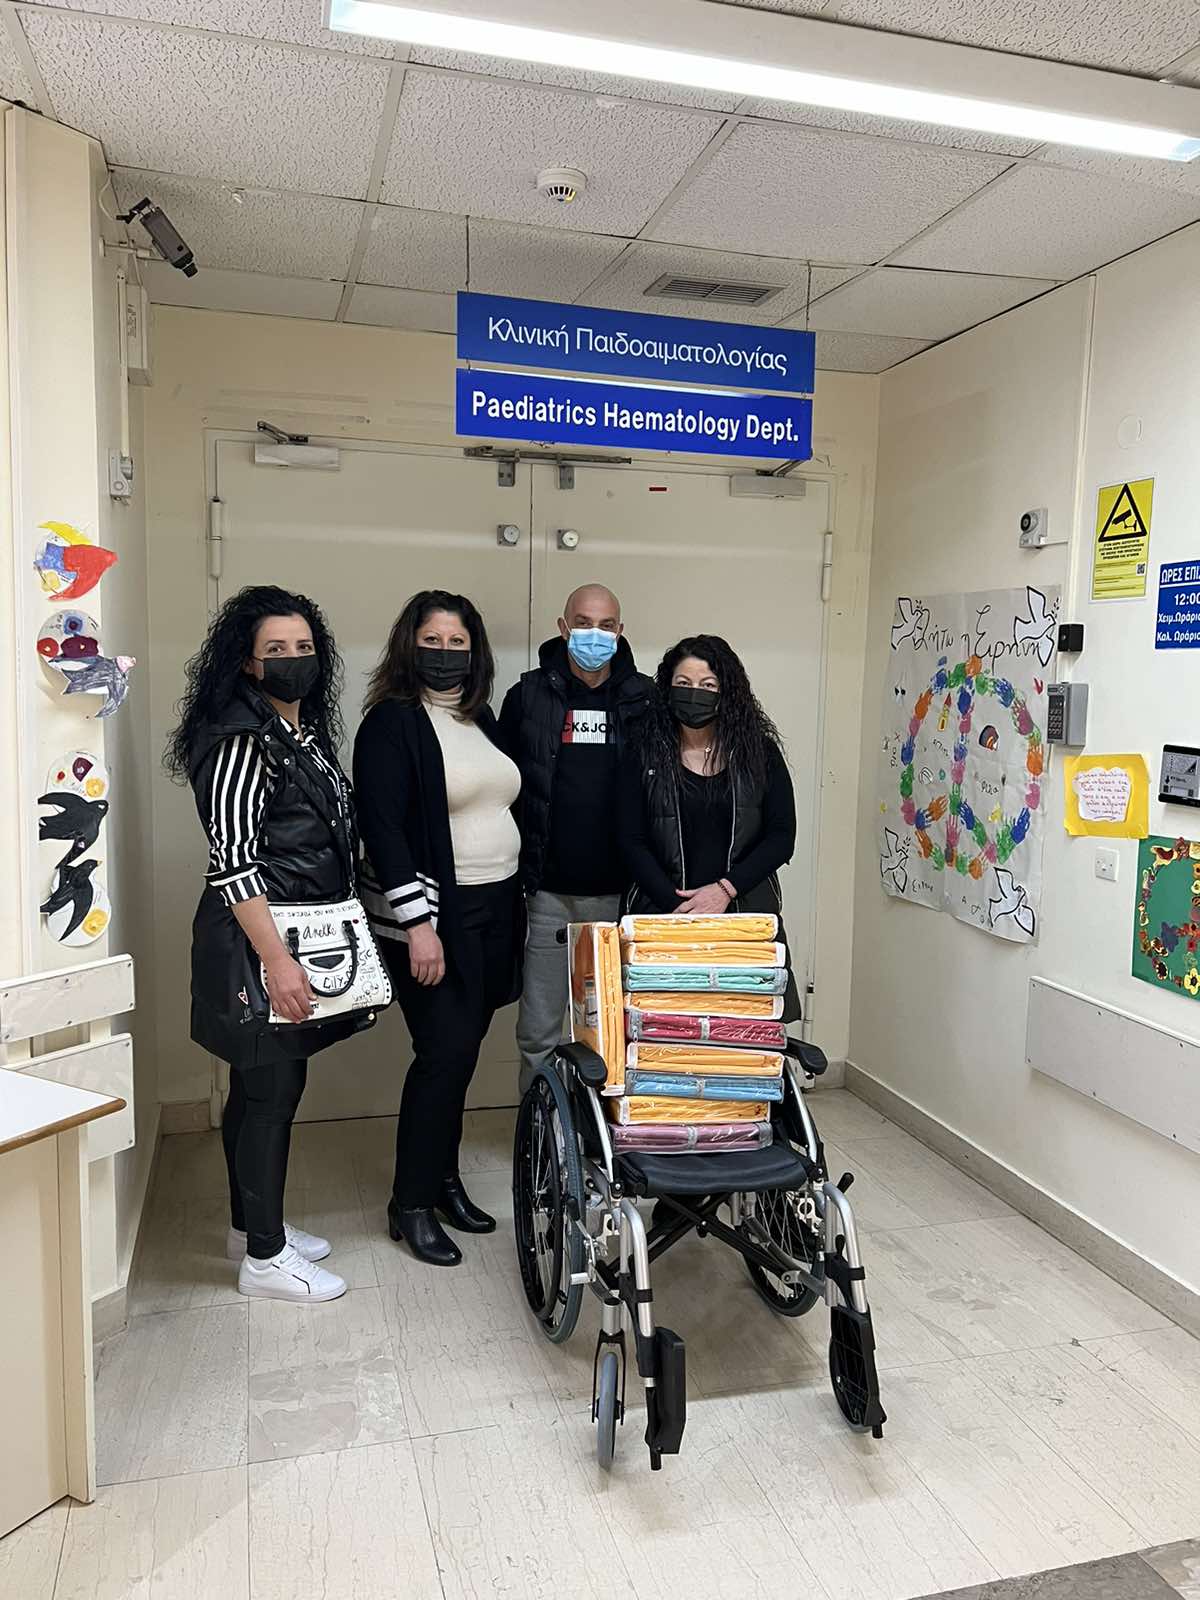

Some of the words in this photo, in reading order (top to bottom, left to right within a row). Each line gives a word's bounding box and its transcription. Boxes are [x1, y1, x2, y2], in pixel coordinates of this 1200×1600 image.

[488, 316, 570, 355] Κλινική
[576, 327, 788, 376] Παιδοαιματολογίας
[472, 390, 596, 426] Paediatrics
[603, 402, 741, 442] Haematology
[745, 414, 800, 445] Dept.
[1161, 567, 1184, 583] ΩΡΕΣ
[1184, 565, 1200, 581] ΕΠΙ
